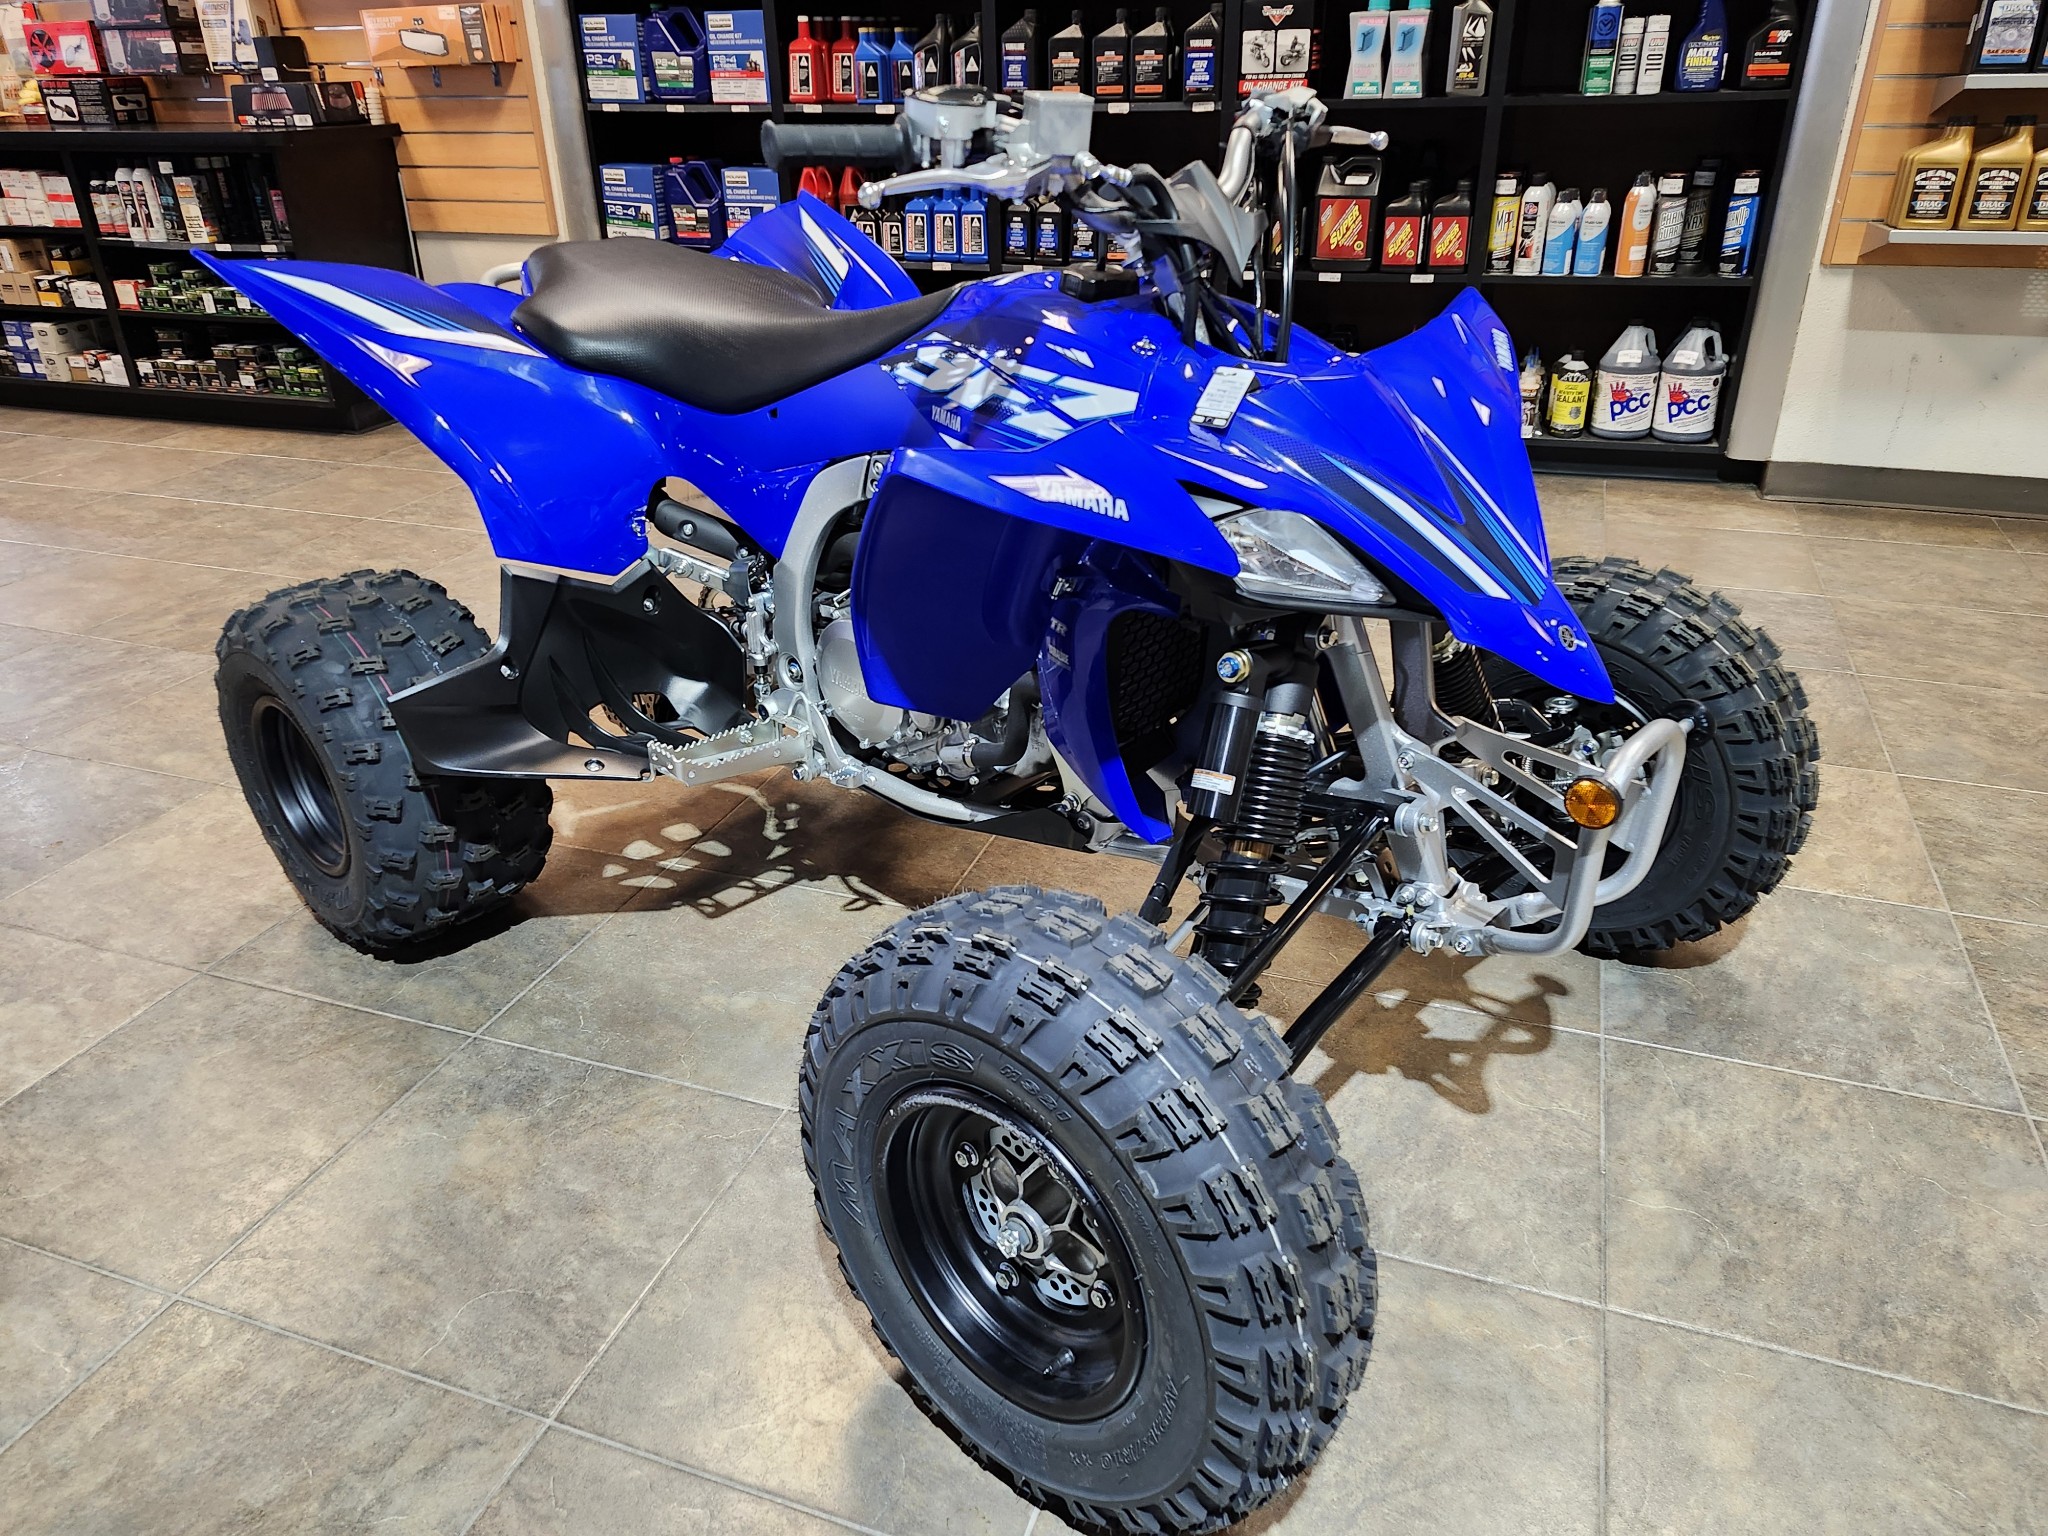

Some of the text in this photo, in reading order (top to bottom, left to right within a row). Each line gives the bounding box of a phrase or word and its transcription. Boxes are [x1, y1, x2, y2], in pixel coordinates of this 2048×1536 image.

[1688, 47, 1720, 57] MATTE
[1685, 57, 1713, 67] FINISH
[1257, 82, 1289, 92] CHANGE
[1915, 170, 1957, 181] GEAR
[1978, 170, 2019, 182] GEAR
[931, 405, 961, 432] YAMAHA
[1034, 475, 1130, 522] YAMAHA
[829, 1038, 975, 1229] MAXXIS
